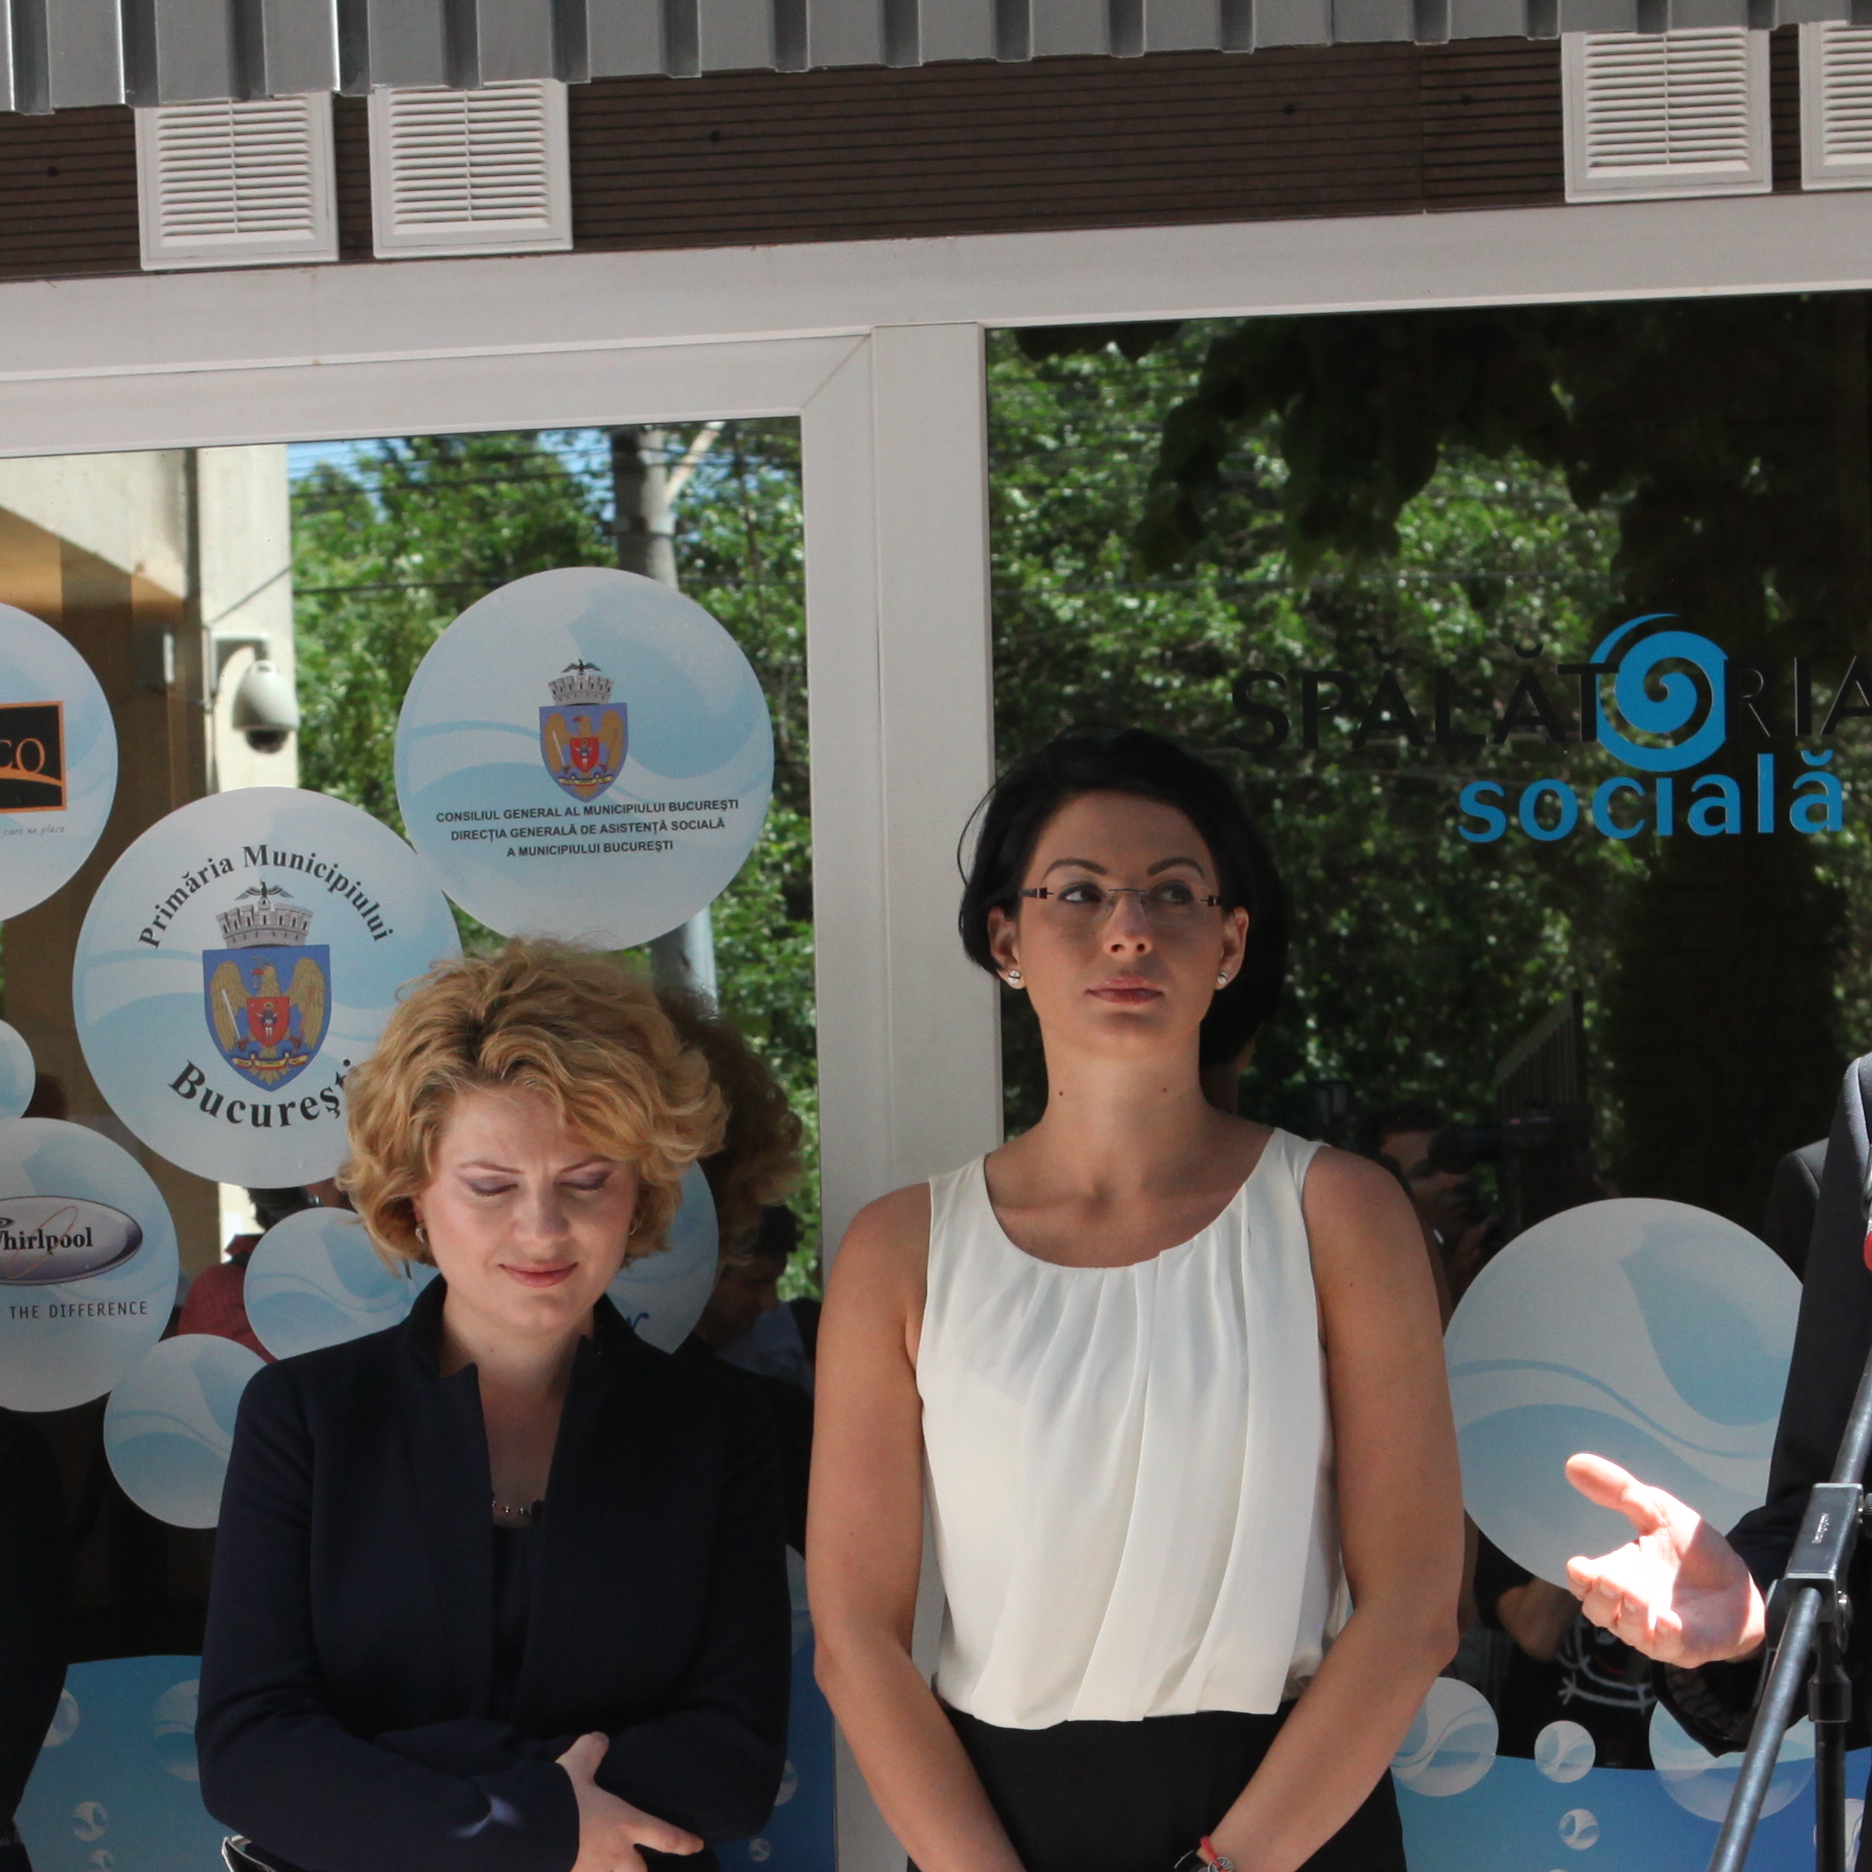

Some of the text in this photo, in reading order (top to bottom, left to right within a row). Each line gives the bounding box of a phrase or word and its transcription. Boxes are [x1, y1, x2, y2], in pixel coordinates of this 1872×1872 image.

[1457, 748, 1844, 844] socială
[436, 810, 500, 823] CONSILIUL
[503, 806, 562, 820] GENERAL
[565, 806, 580, 817] AL
[583, 801, 665, 816] MUNICIPIULUI
[510, 822, 577, 838] GENERALĂ
[580, 823, 596, 835] DE
[671, 816, 725, 831] SOCIALĂ
[506, 847, 516, 857] A
[518, 842, 601, 856] MUNICIPIULUI
[138, 844, 395, 949] Primăria Municipiului
[167, 1058, 352, 1128] Bucureş
[9, 1304, 39, 1319] THE
[49, 1300, 148, 1319] DIFFERENCE
